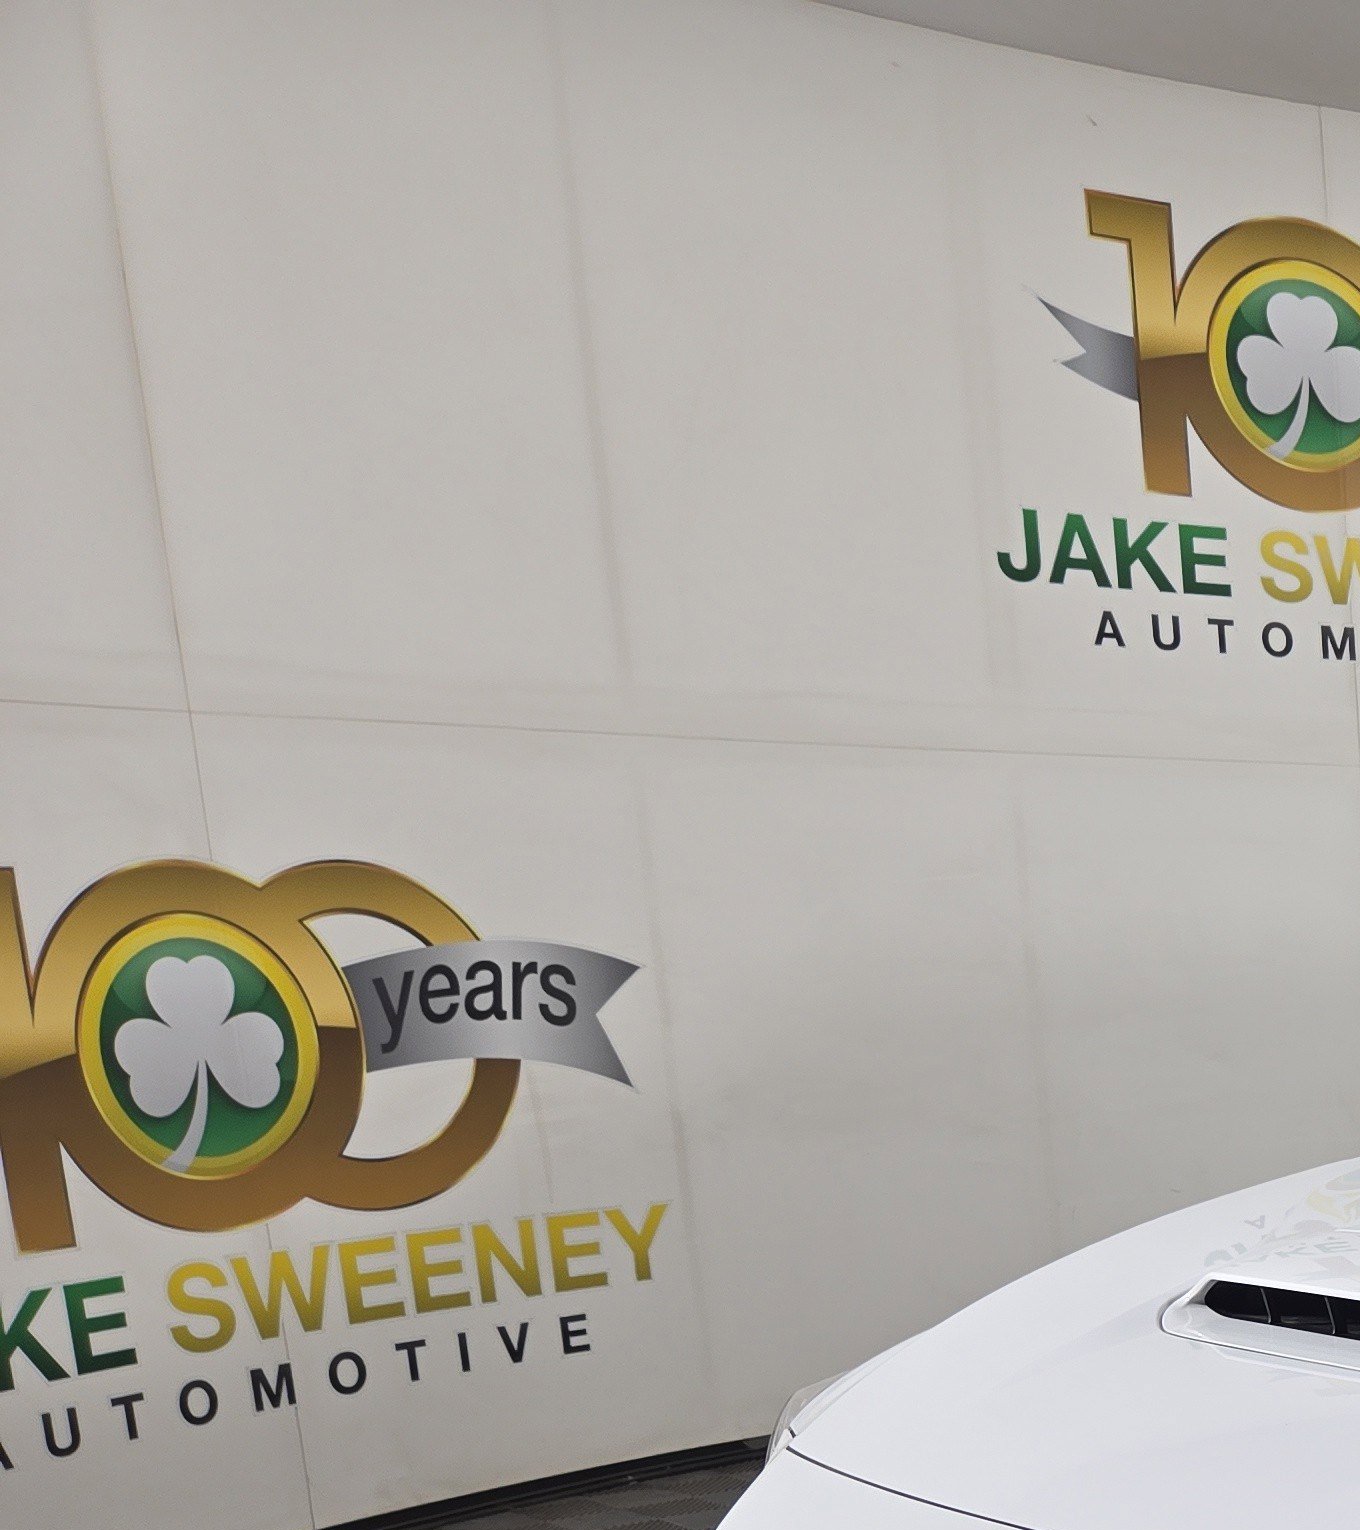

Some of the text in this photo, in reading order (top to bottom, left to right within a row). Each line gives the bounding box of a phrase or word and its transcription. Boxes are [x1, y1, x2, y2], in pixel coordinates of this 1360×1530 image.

[997, 506, 1233, 597] JAKE
[371, 959, 579, 1054] years
[167, 1203, 669, 1354] SWEENEY
